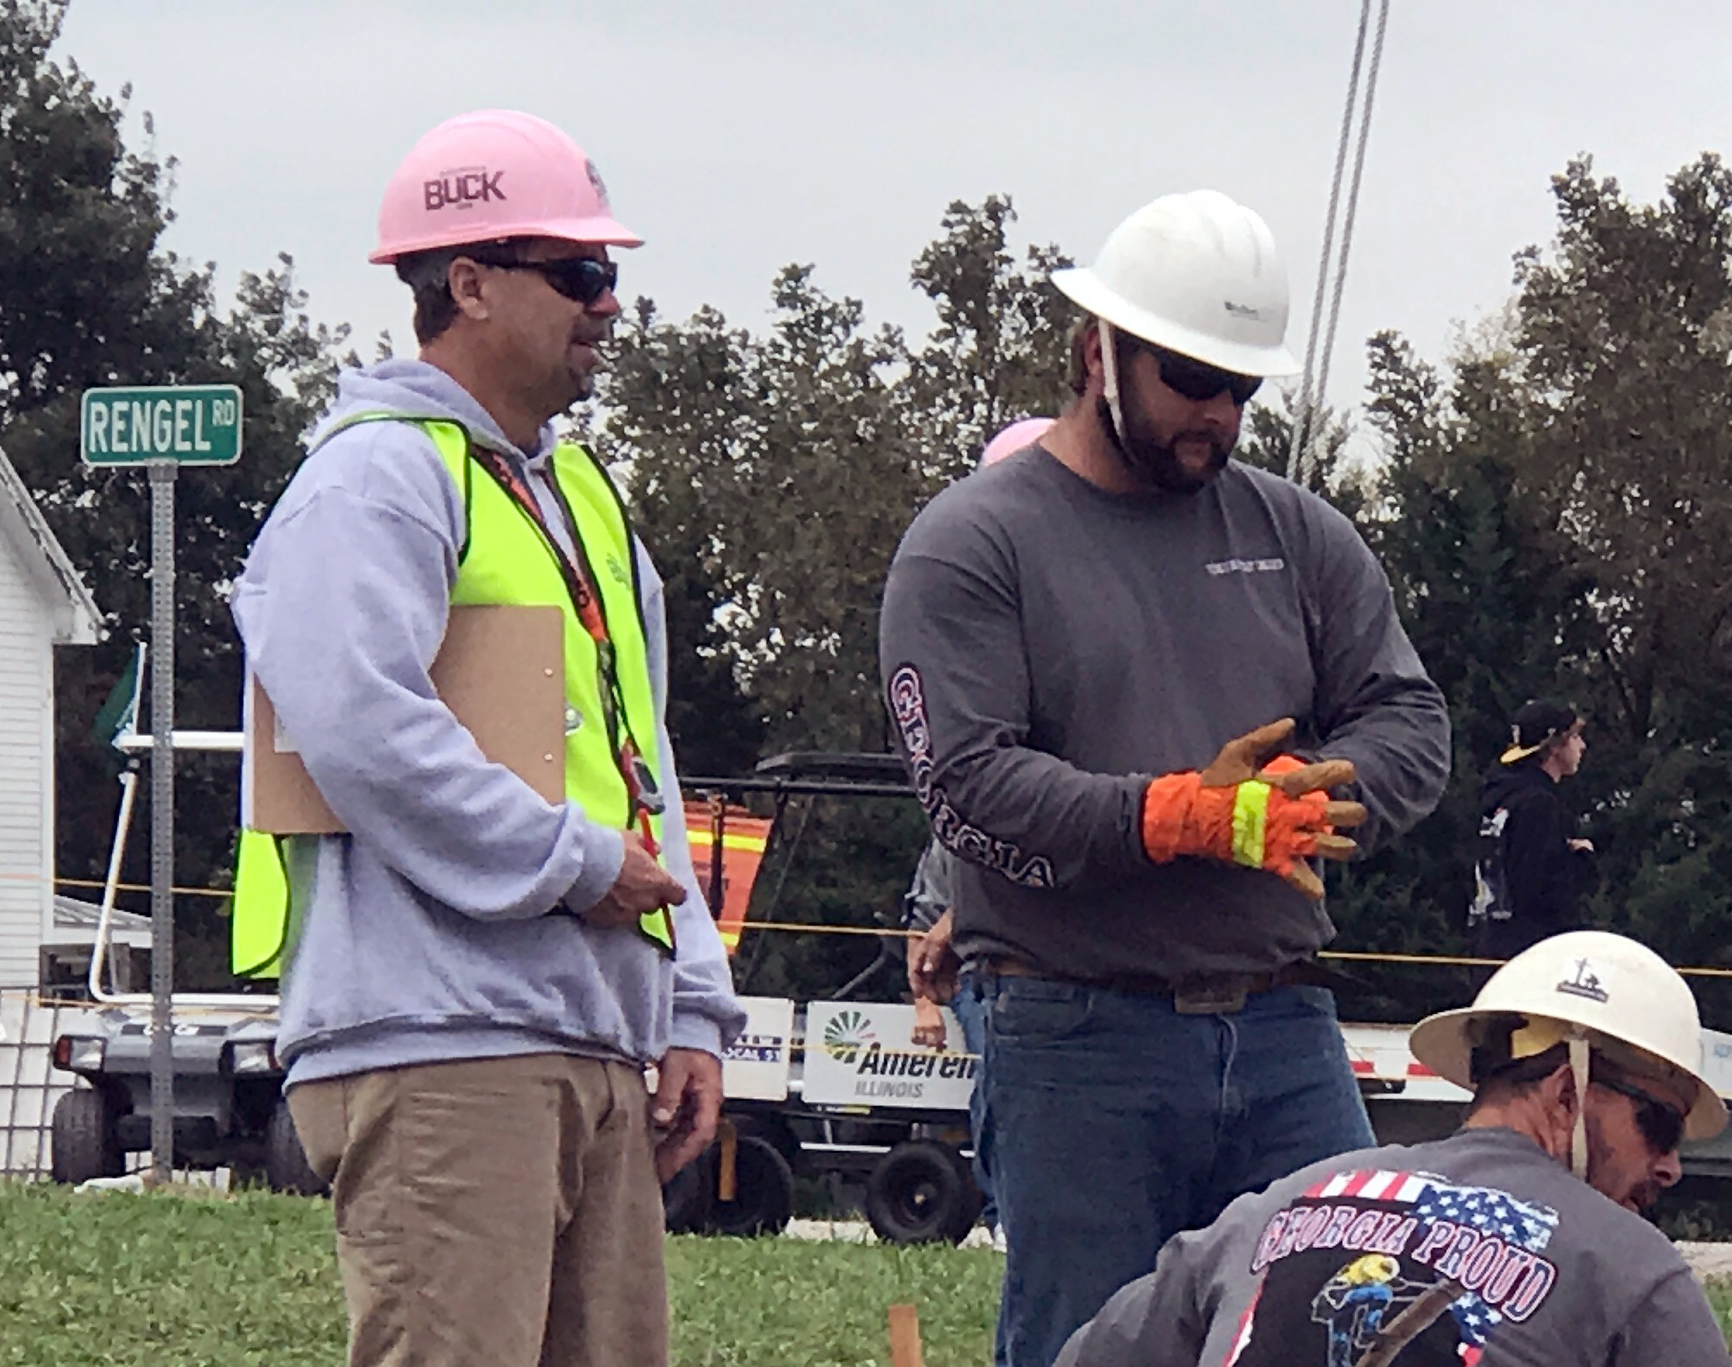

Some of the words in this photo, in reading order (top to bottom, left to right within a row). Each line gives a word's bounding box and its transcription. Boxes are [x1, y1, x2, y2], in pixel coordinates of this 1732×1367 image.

[424, 171, 507, 210] BUCK
[89, 399, 211, 453] RENGEL
[212, 399, 235, 426] RD
[889, 664, 1055, 889] GEORGIA
[855, 1082, 923, 1099] ILLINOIS
[1250, 1204, 1418, 1274] GEORGIA
[1411, 1221, 1558, 1324] PROUD
